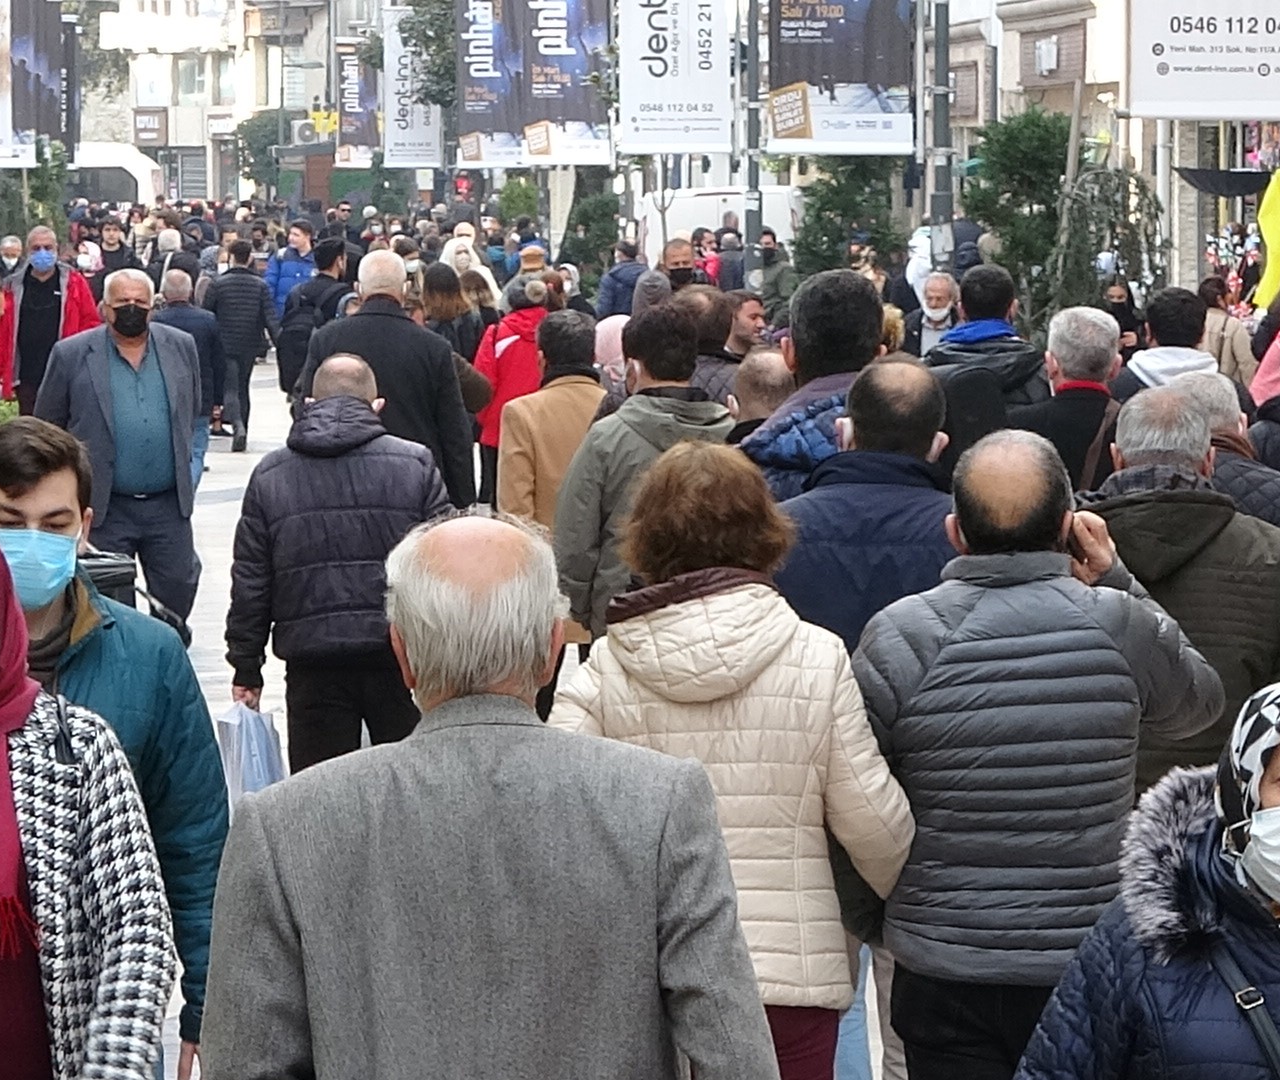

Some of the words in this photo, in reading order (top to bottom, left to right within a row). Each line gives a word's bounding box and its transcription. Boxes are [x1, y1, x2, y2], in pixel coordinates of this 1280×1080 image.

[1170, 16, 1217, 34] 0546
[1225, 17, 1259, 34] 112
[698, 28, 713, 70] 0452
